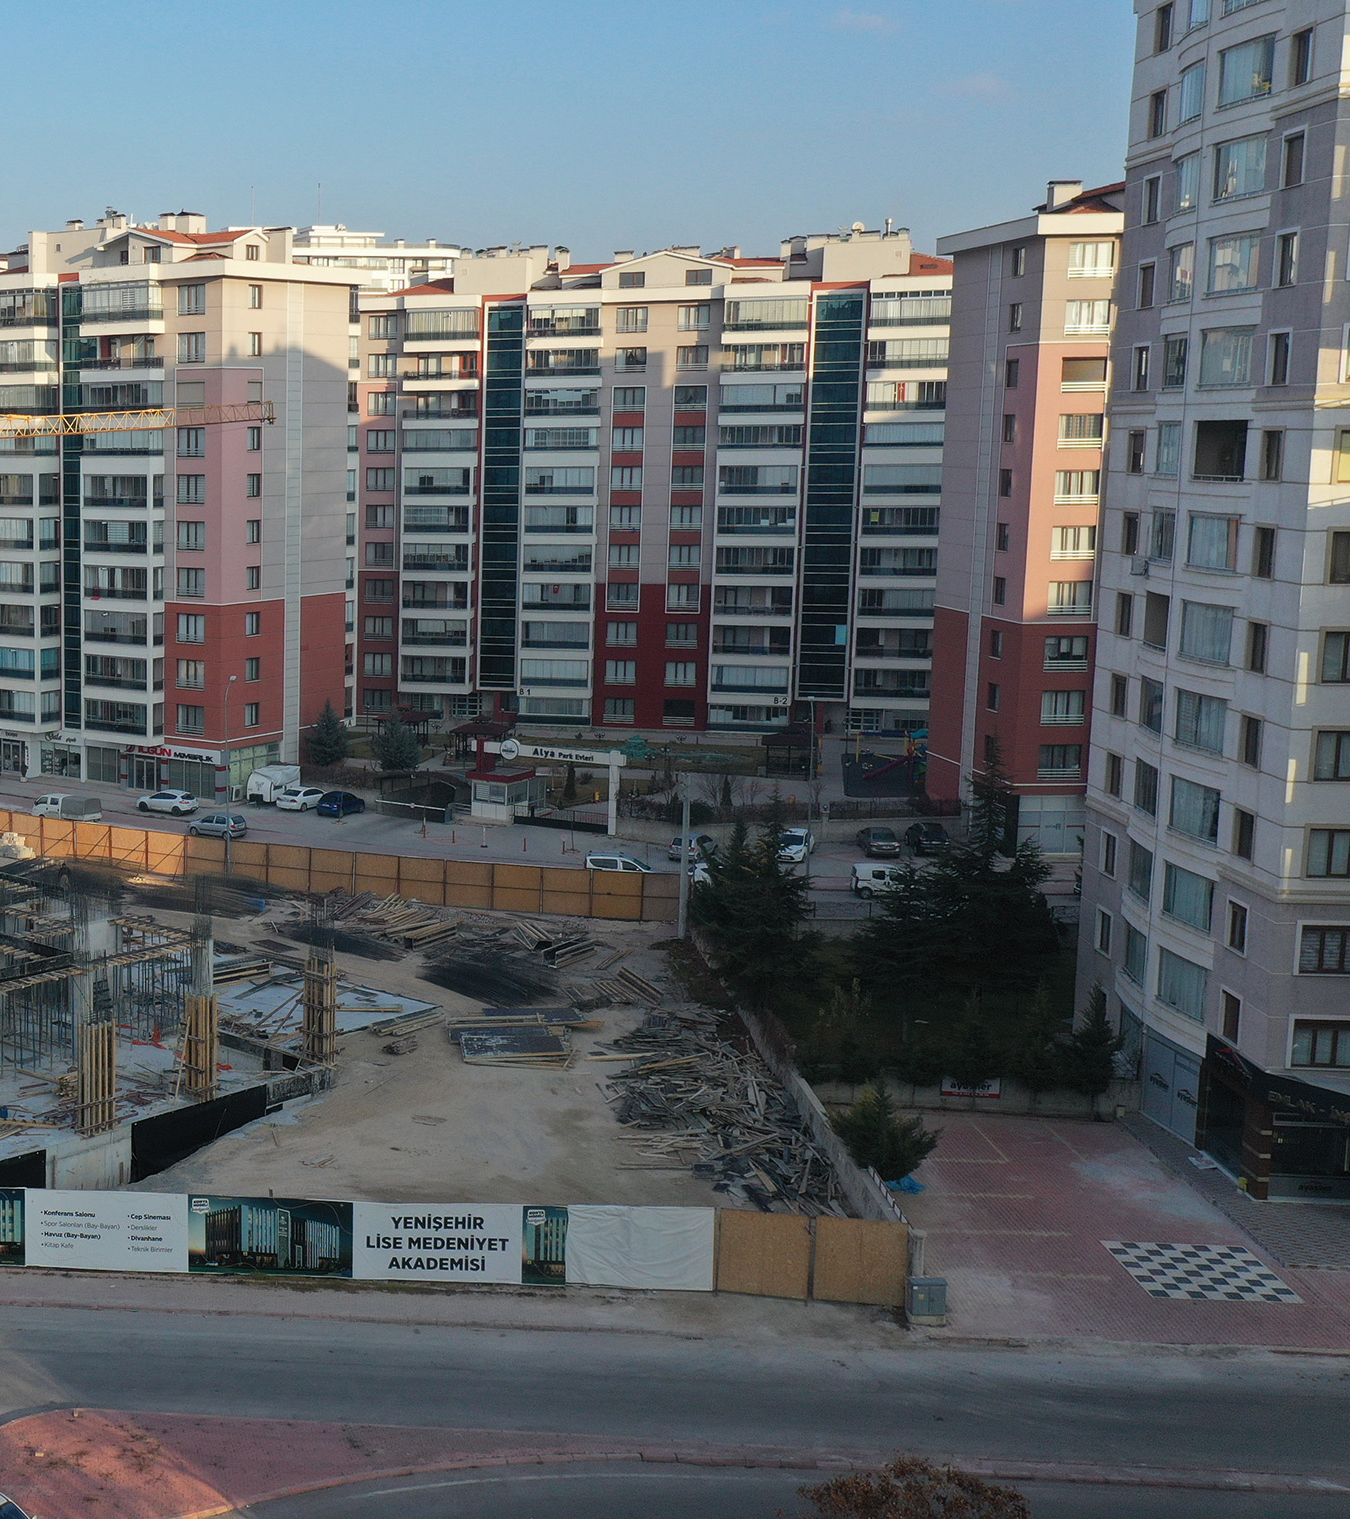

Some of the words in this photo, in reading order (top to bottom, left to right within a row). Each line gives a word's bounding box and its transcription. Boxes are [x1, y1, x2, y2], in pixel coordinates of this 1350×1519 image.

[532, 748, 555, 758] Alya
[558, 752, 573, 760] Park
[575, 754, 594, 762] Evleri
[44, 1220, 57, 1228] Spor
[84, 1223, 121, 1231] (Bay-Bayan)
[391, 1214, 484, 1231] YENİŞEHİR
[63, 1232, 101, 1240] (Bay-Bayan)
[366, 1234, 403, 1249] LİSE
[408, 1235, 509, 1251] MEDENİYET
[388, 1256, 486, 1271] AKADEMİSİ
